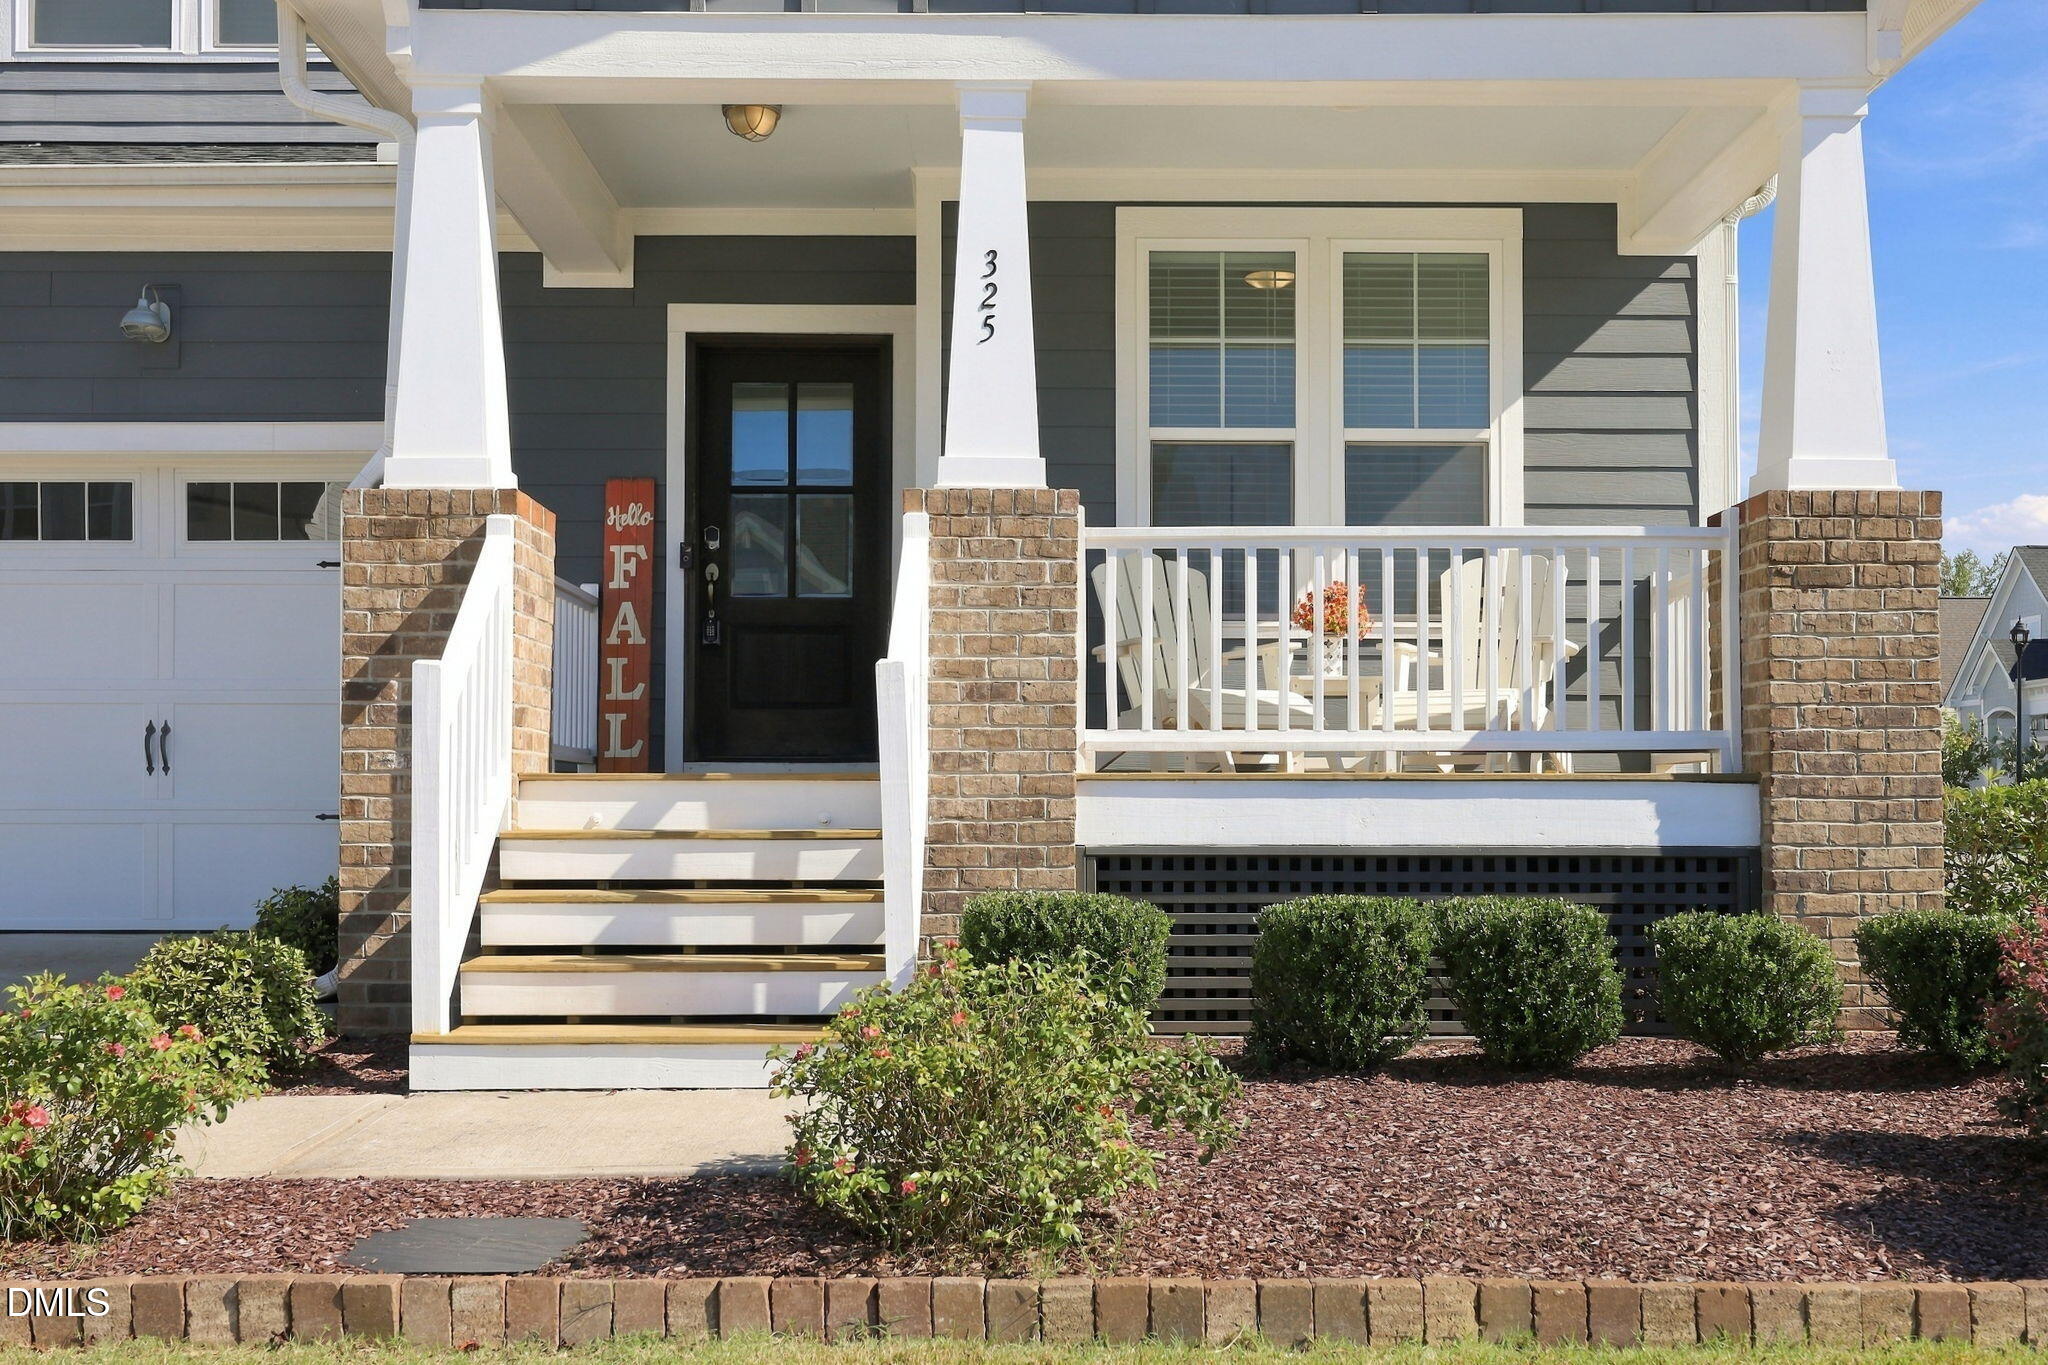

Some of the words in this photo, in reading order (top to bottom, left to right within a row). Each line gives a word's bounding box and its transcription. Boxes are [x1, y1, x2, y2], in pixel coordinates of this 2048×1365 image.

[977, 249, 998, 345] 325
[607, 502, 654, 532] Hello
[604, 545, 648, 758] FALL
